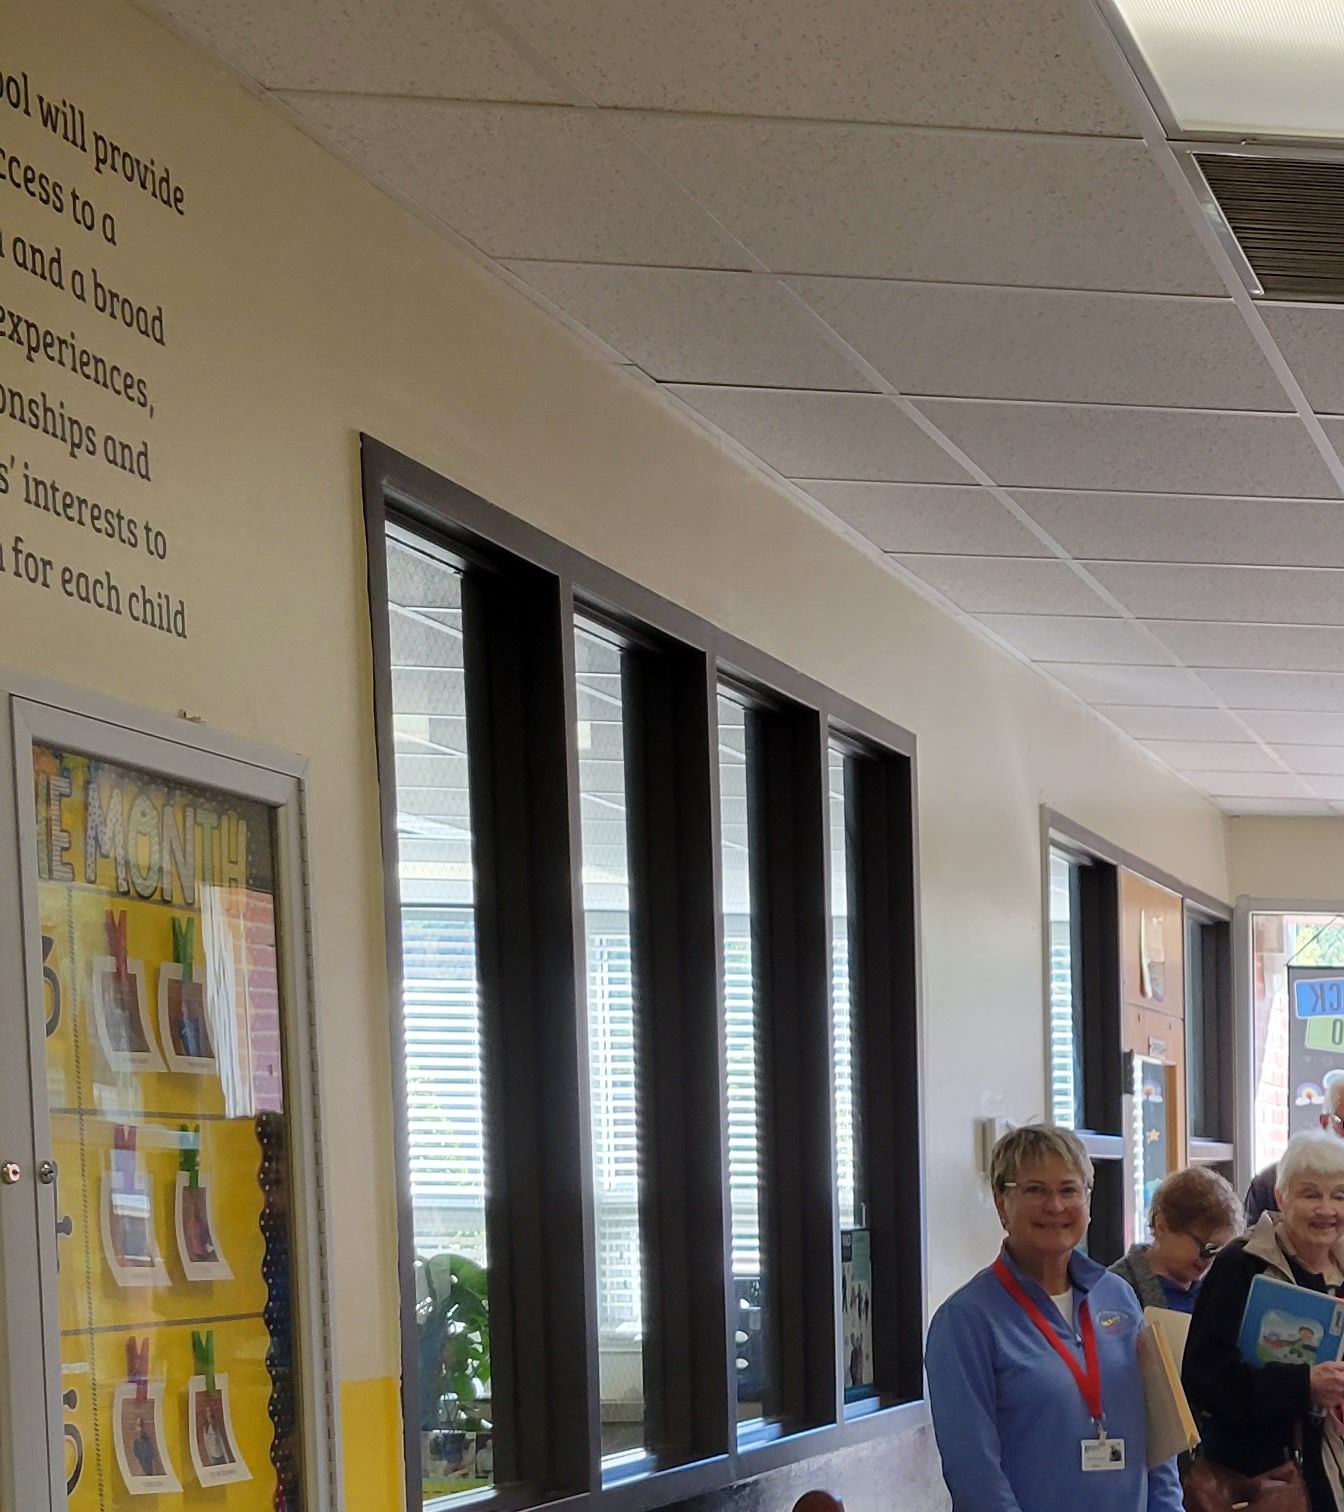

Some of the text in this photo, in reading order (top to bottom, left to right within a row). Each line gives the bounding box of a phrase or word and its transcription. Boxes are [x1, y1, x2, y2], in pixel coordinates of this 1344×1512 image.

[0, 71, 184, 215] ol will provide
[71, 187, 95, 231] to
[102, 213, 117, 246] a
[13, 236, 64, 290] and
[71, 269, 86, 303] a
[92, 267, 166, 346] broad
[104, 434, 151, 481] and
[23, 462, 138, 548] interests
[144, 520, 167, 560] to
[12, 536, 53, 588] for
[61, 566, 122, 615] each
[128, 585, 187, 639] child
[86, 782, 247, 906] MONTH
